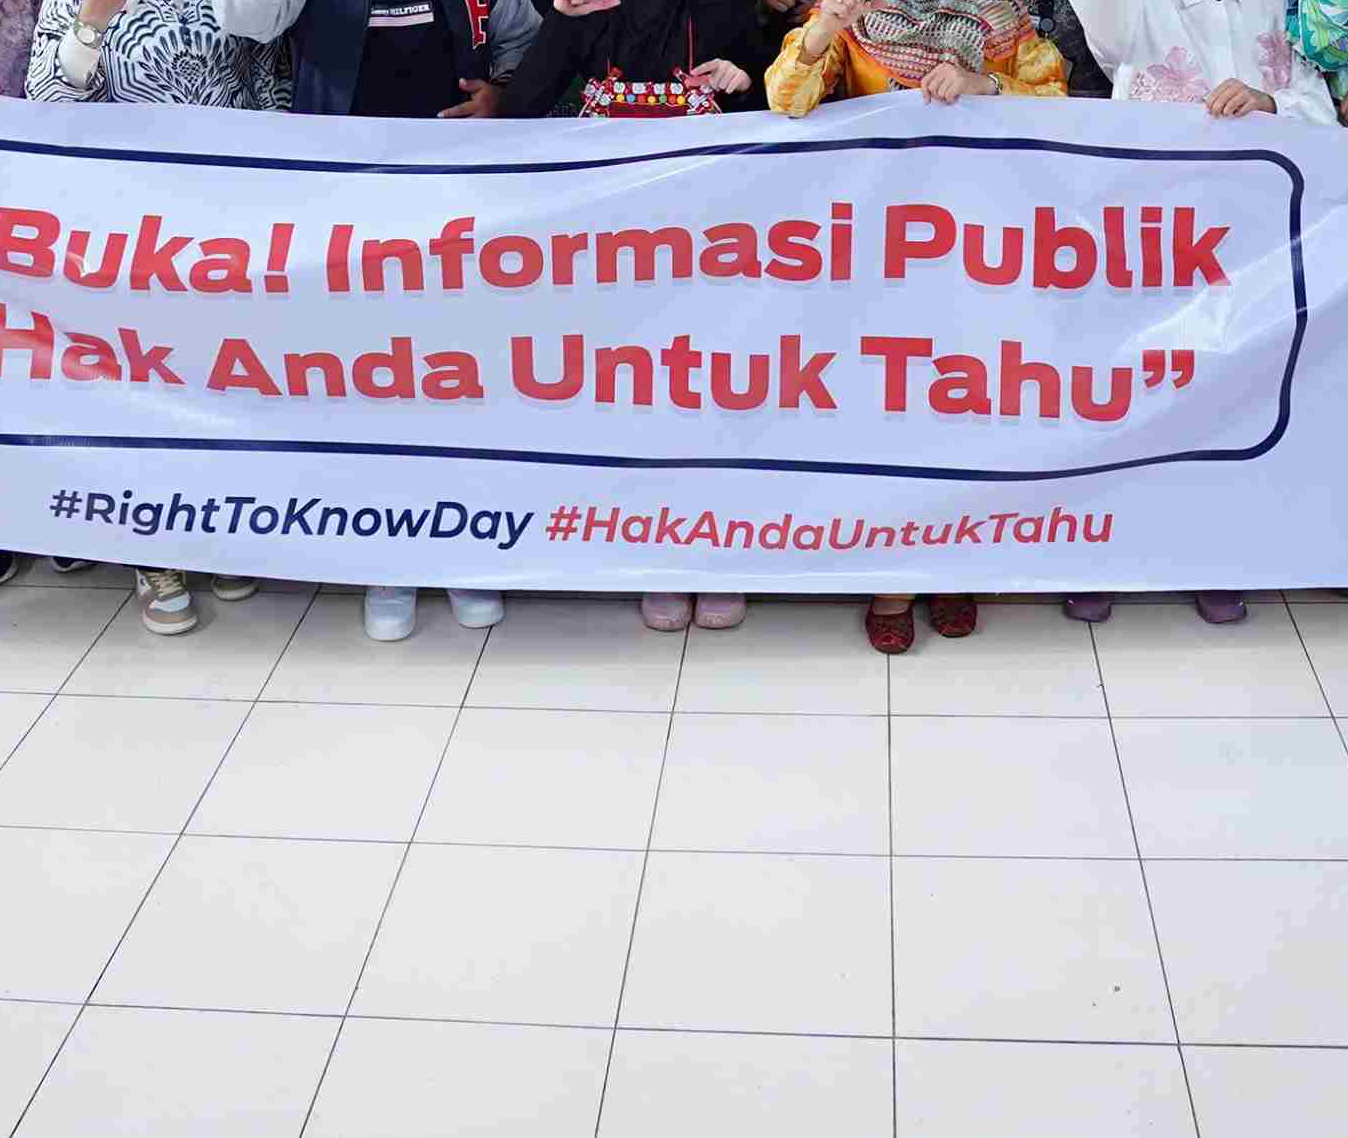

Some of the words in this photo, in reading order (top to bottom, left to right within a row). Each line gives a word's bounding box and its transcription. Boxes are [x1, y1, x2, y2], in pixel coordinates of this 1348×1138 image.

[325, 201, 854, 294] Informasi
[883, 204, 1230, 291] Publik
[207, 336, 485, 400] Anda
[511, 333, 838, 411] Untuk
[859, 335, 1196, 423] Tahu”
[49, 488, 535, 551] #RightToKnowDay
[545, 505, 1114, 552] #HakAndaUntukTahu
